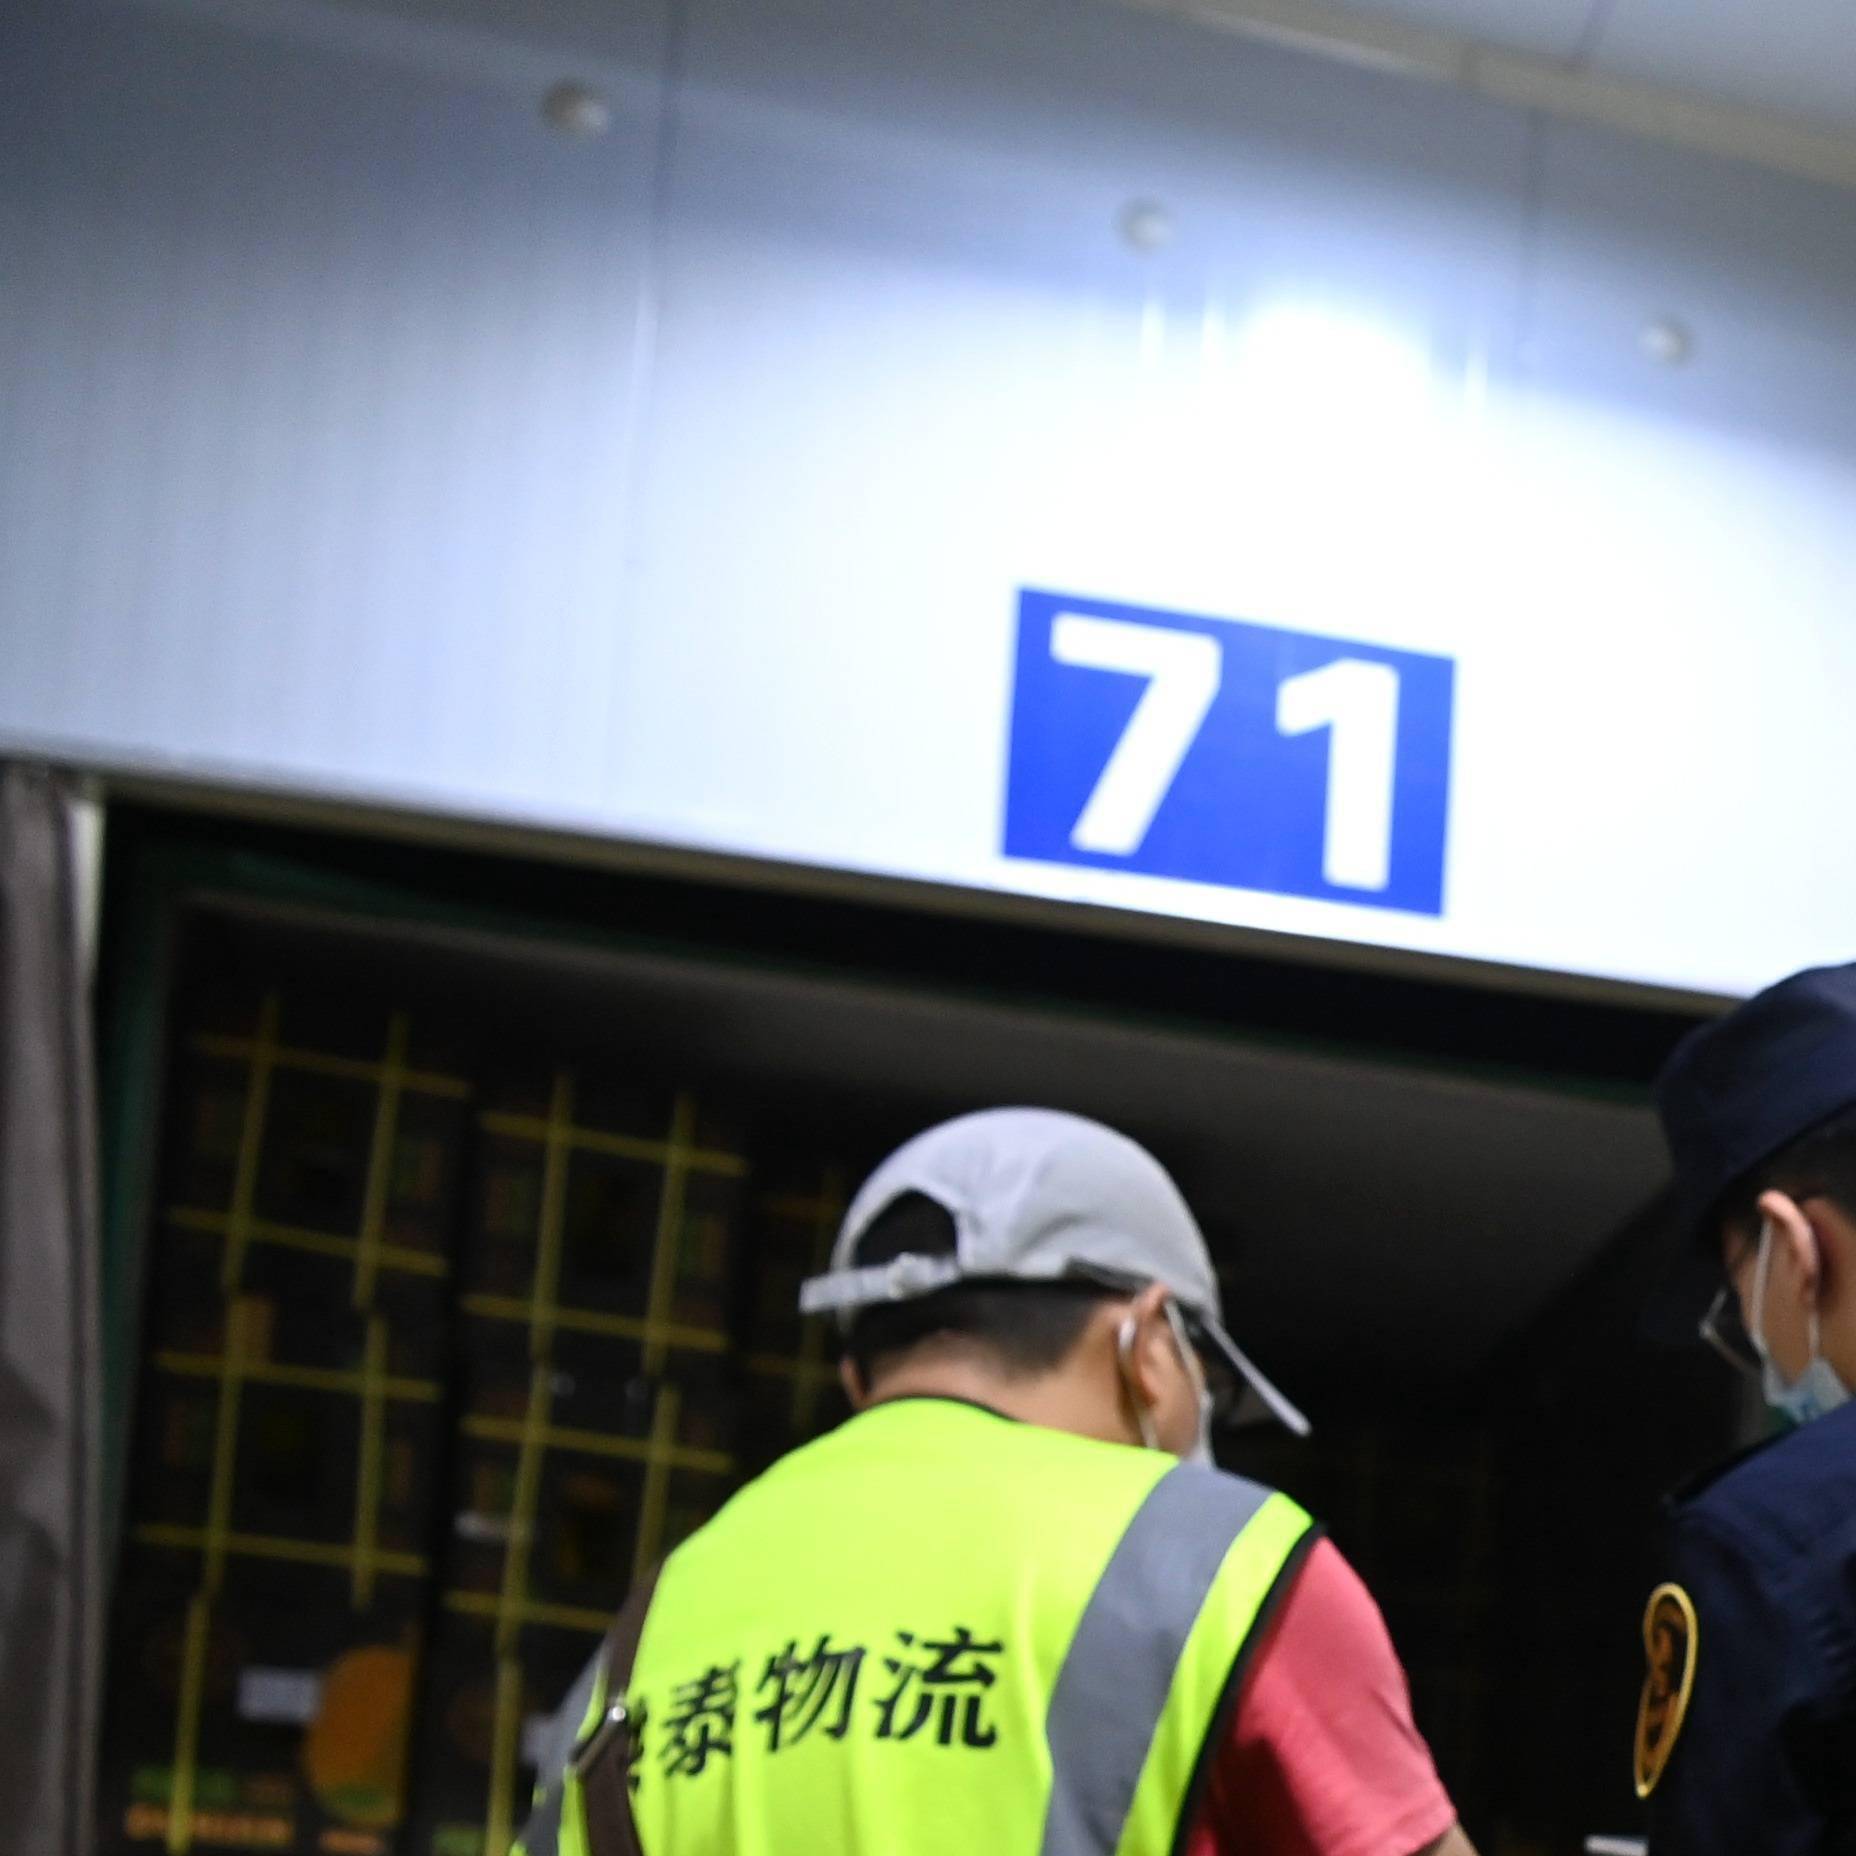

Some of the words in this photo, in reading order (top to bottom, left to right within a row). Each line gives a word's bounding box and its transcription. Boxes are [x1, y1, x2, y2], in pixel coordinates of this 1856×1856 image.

[1048, 611, 1401, 891] 71
[627, 1627, 1005, 1790] 泰物流
